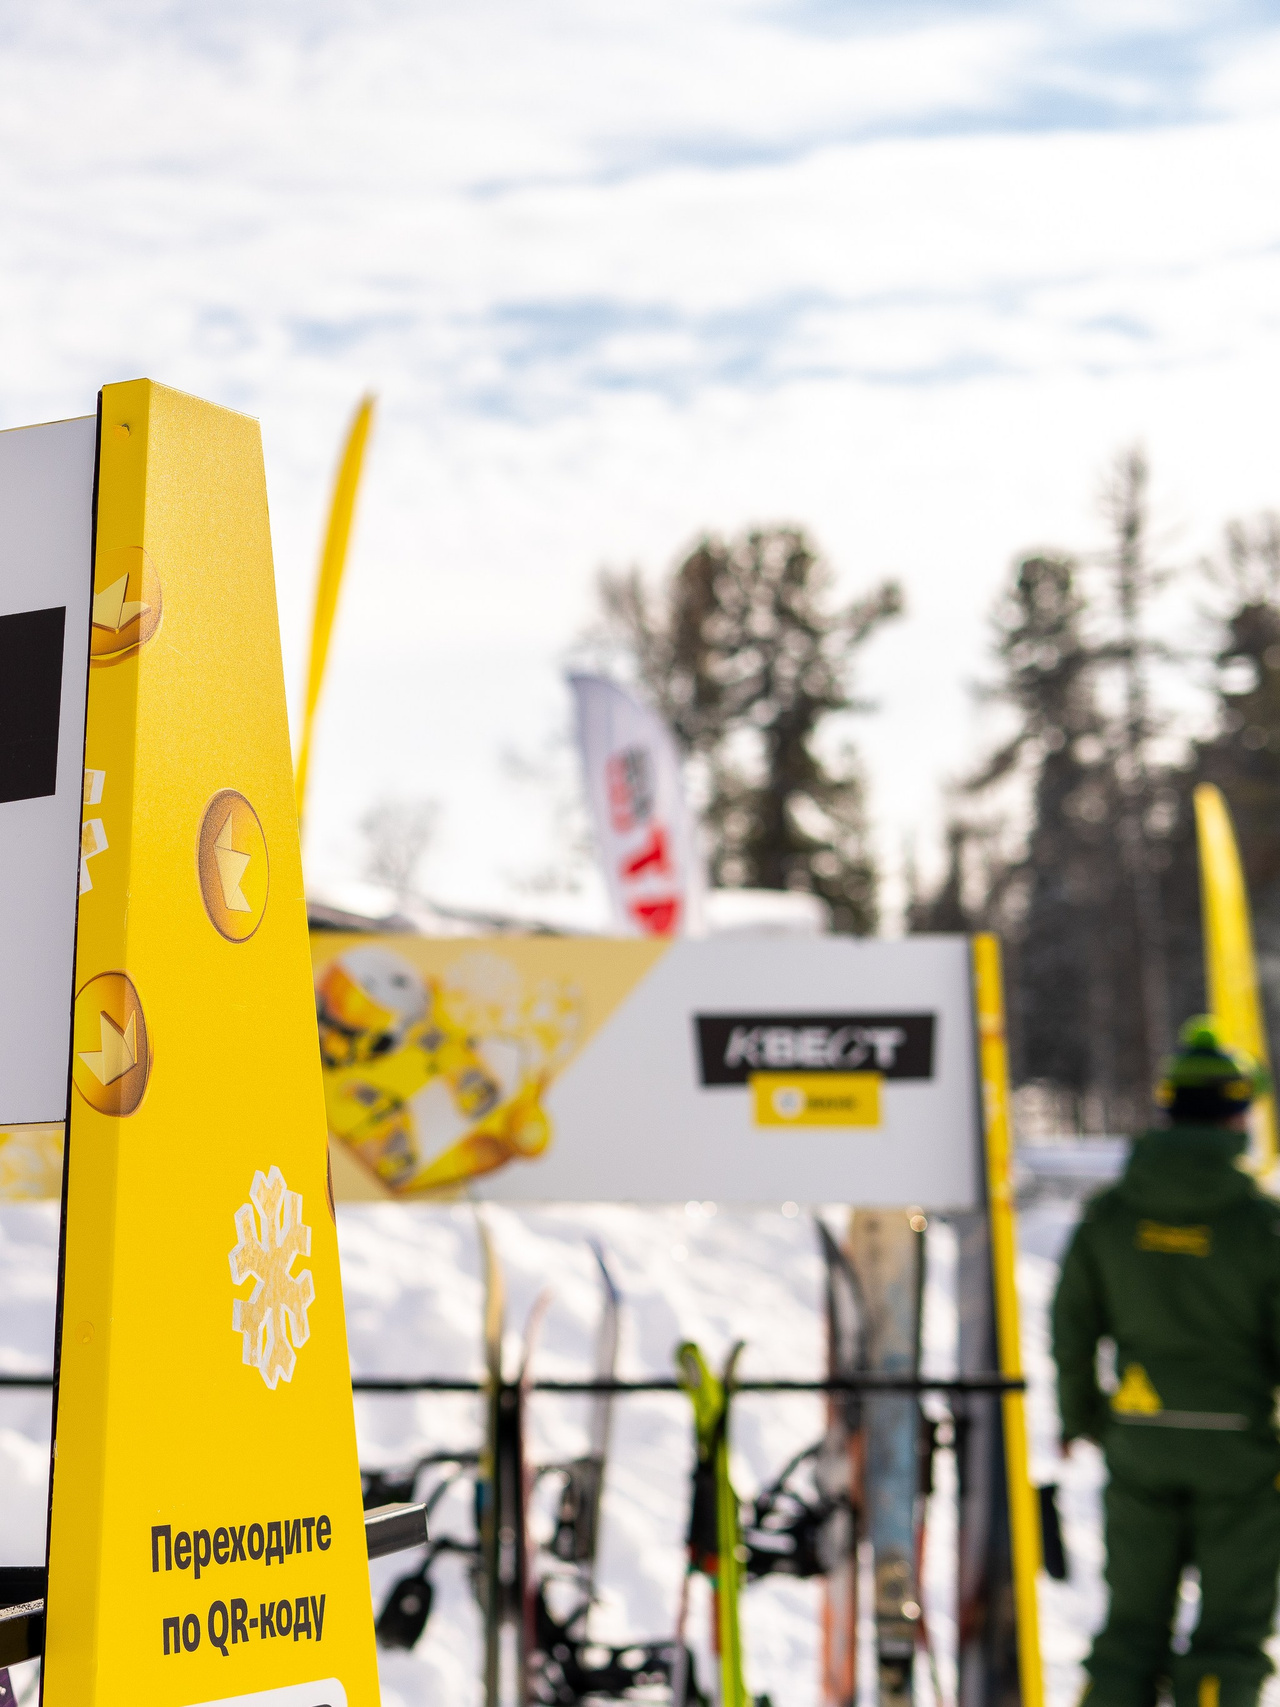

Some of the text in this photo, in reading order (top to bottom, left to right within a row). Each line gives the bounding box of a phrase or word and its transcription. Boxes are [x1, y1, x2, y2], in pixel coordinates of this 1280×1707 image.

[725, 1026, 906, 1068] КВЕСТ
[151, 1515, 332, 1579] Переходите
[163, 1594, 326, 1656] по QR-коду
